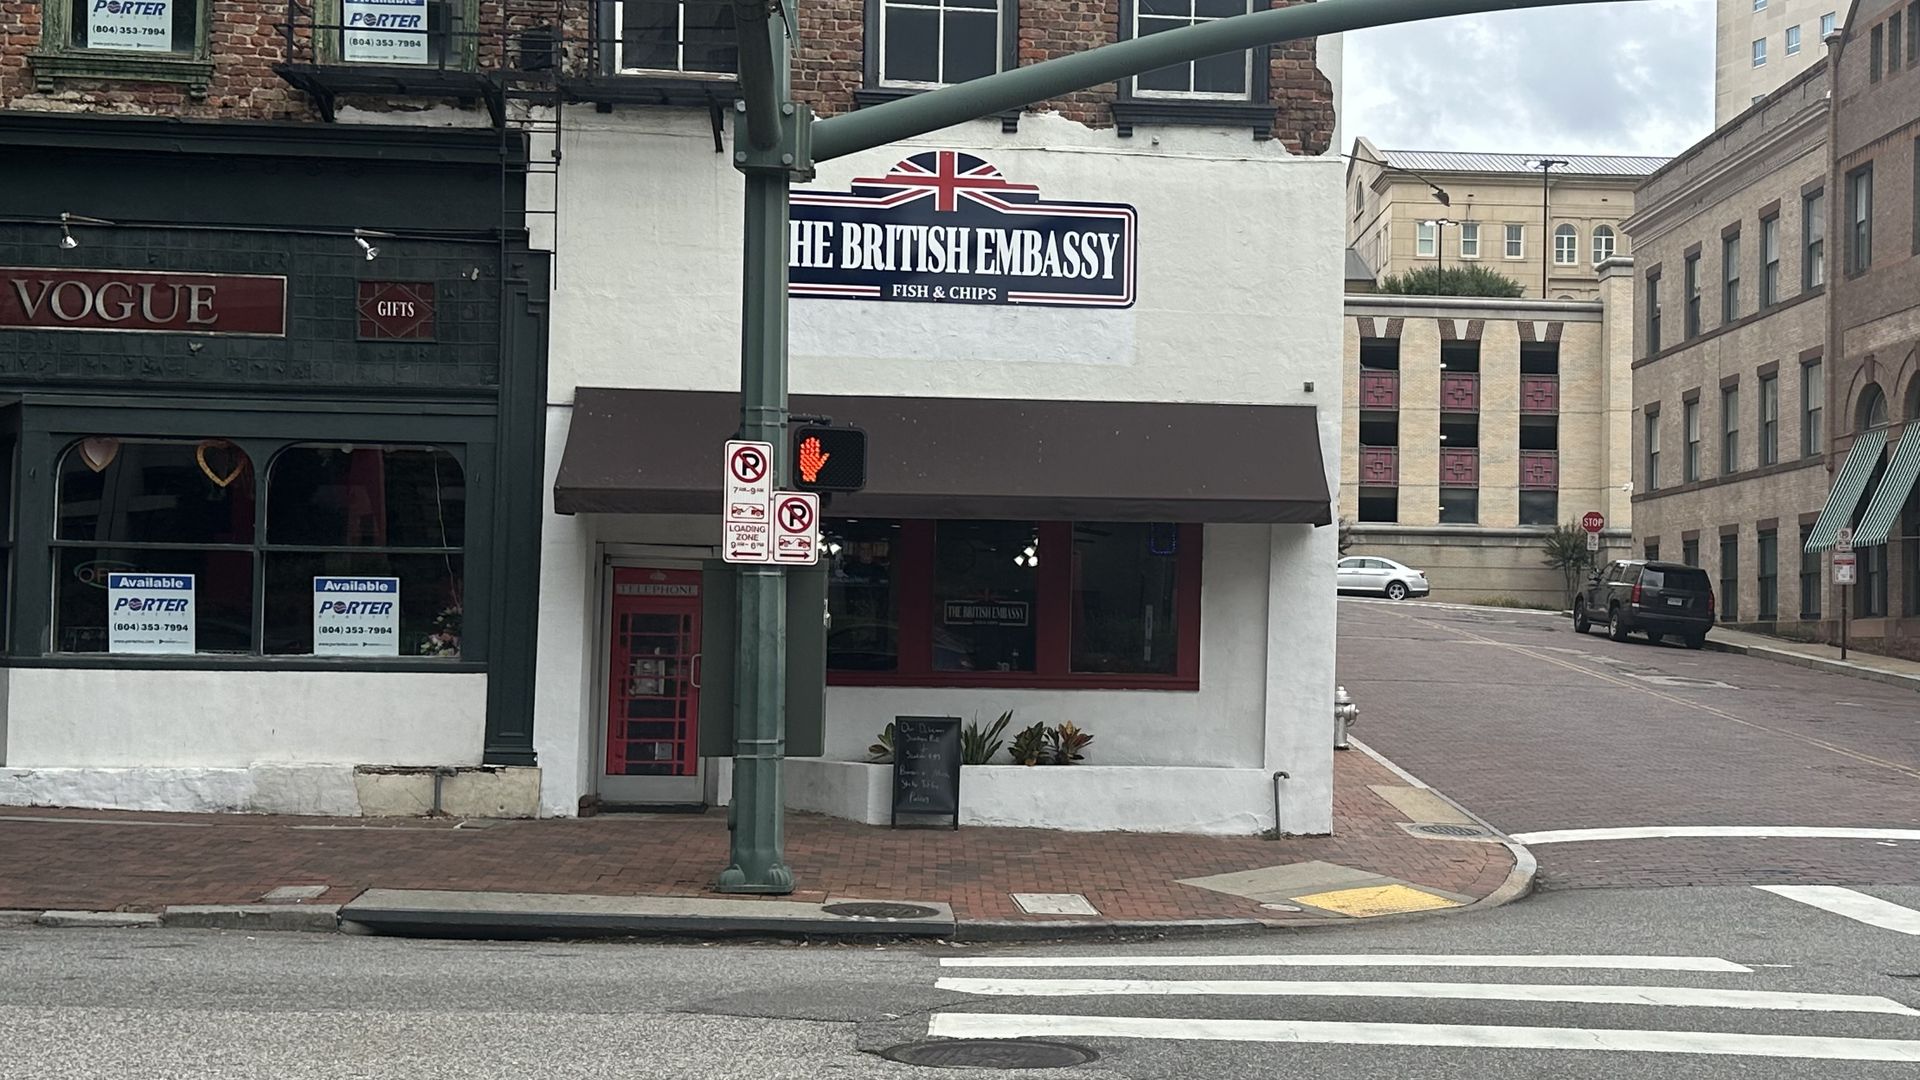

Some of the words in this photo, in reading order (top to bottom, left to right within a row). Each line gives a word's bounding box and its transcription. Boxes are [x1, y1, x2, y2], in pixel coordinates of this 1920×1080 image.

[93, 0, 166, 16] PORTER
[349, 12, 422, 28] PORTER
[788, 220, 834, 268] HE
[840, 221, 970, 275] BRITISH
[974, 228, 1120, 280] EMBASSY
[892, 284, 929, 298] FISH
[933, 285, 946, 299] &
[949, 286, 997, 301] CHIPS
[11, 278, 219, 324] VOGUE
[376, 299, 415, 318] GIFTS
[729, 524, 766, 533] LOADING
[1583, 517, 1604, 527] STOP
[736, 533, 759, 541] ZONE
[119, 577, 184, 588] Available
[324, 580, 389, 591] Available
[114, 597, 189, 612] PORTER
[319, 600, 393, 614] PORTER
[113, 622, 139, 632] (804)
